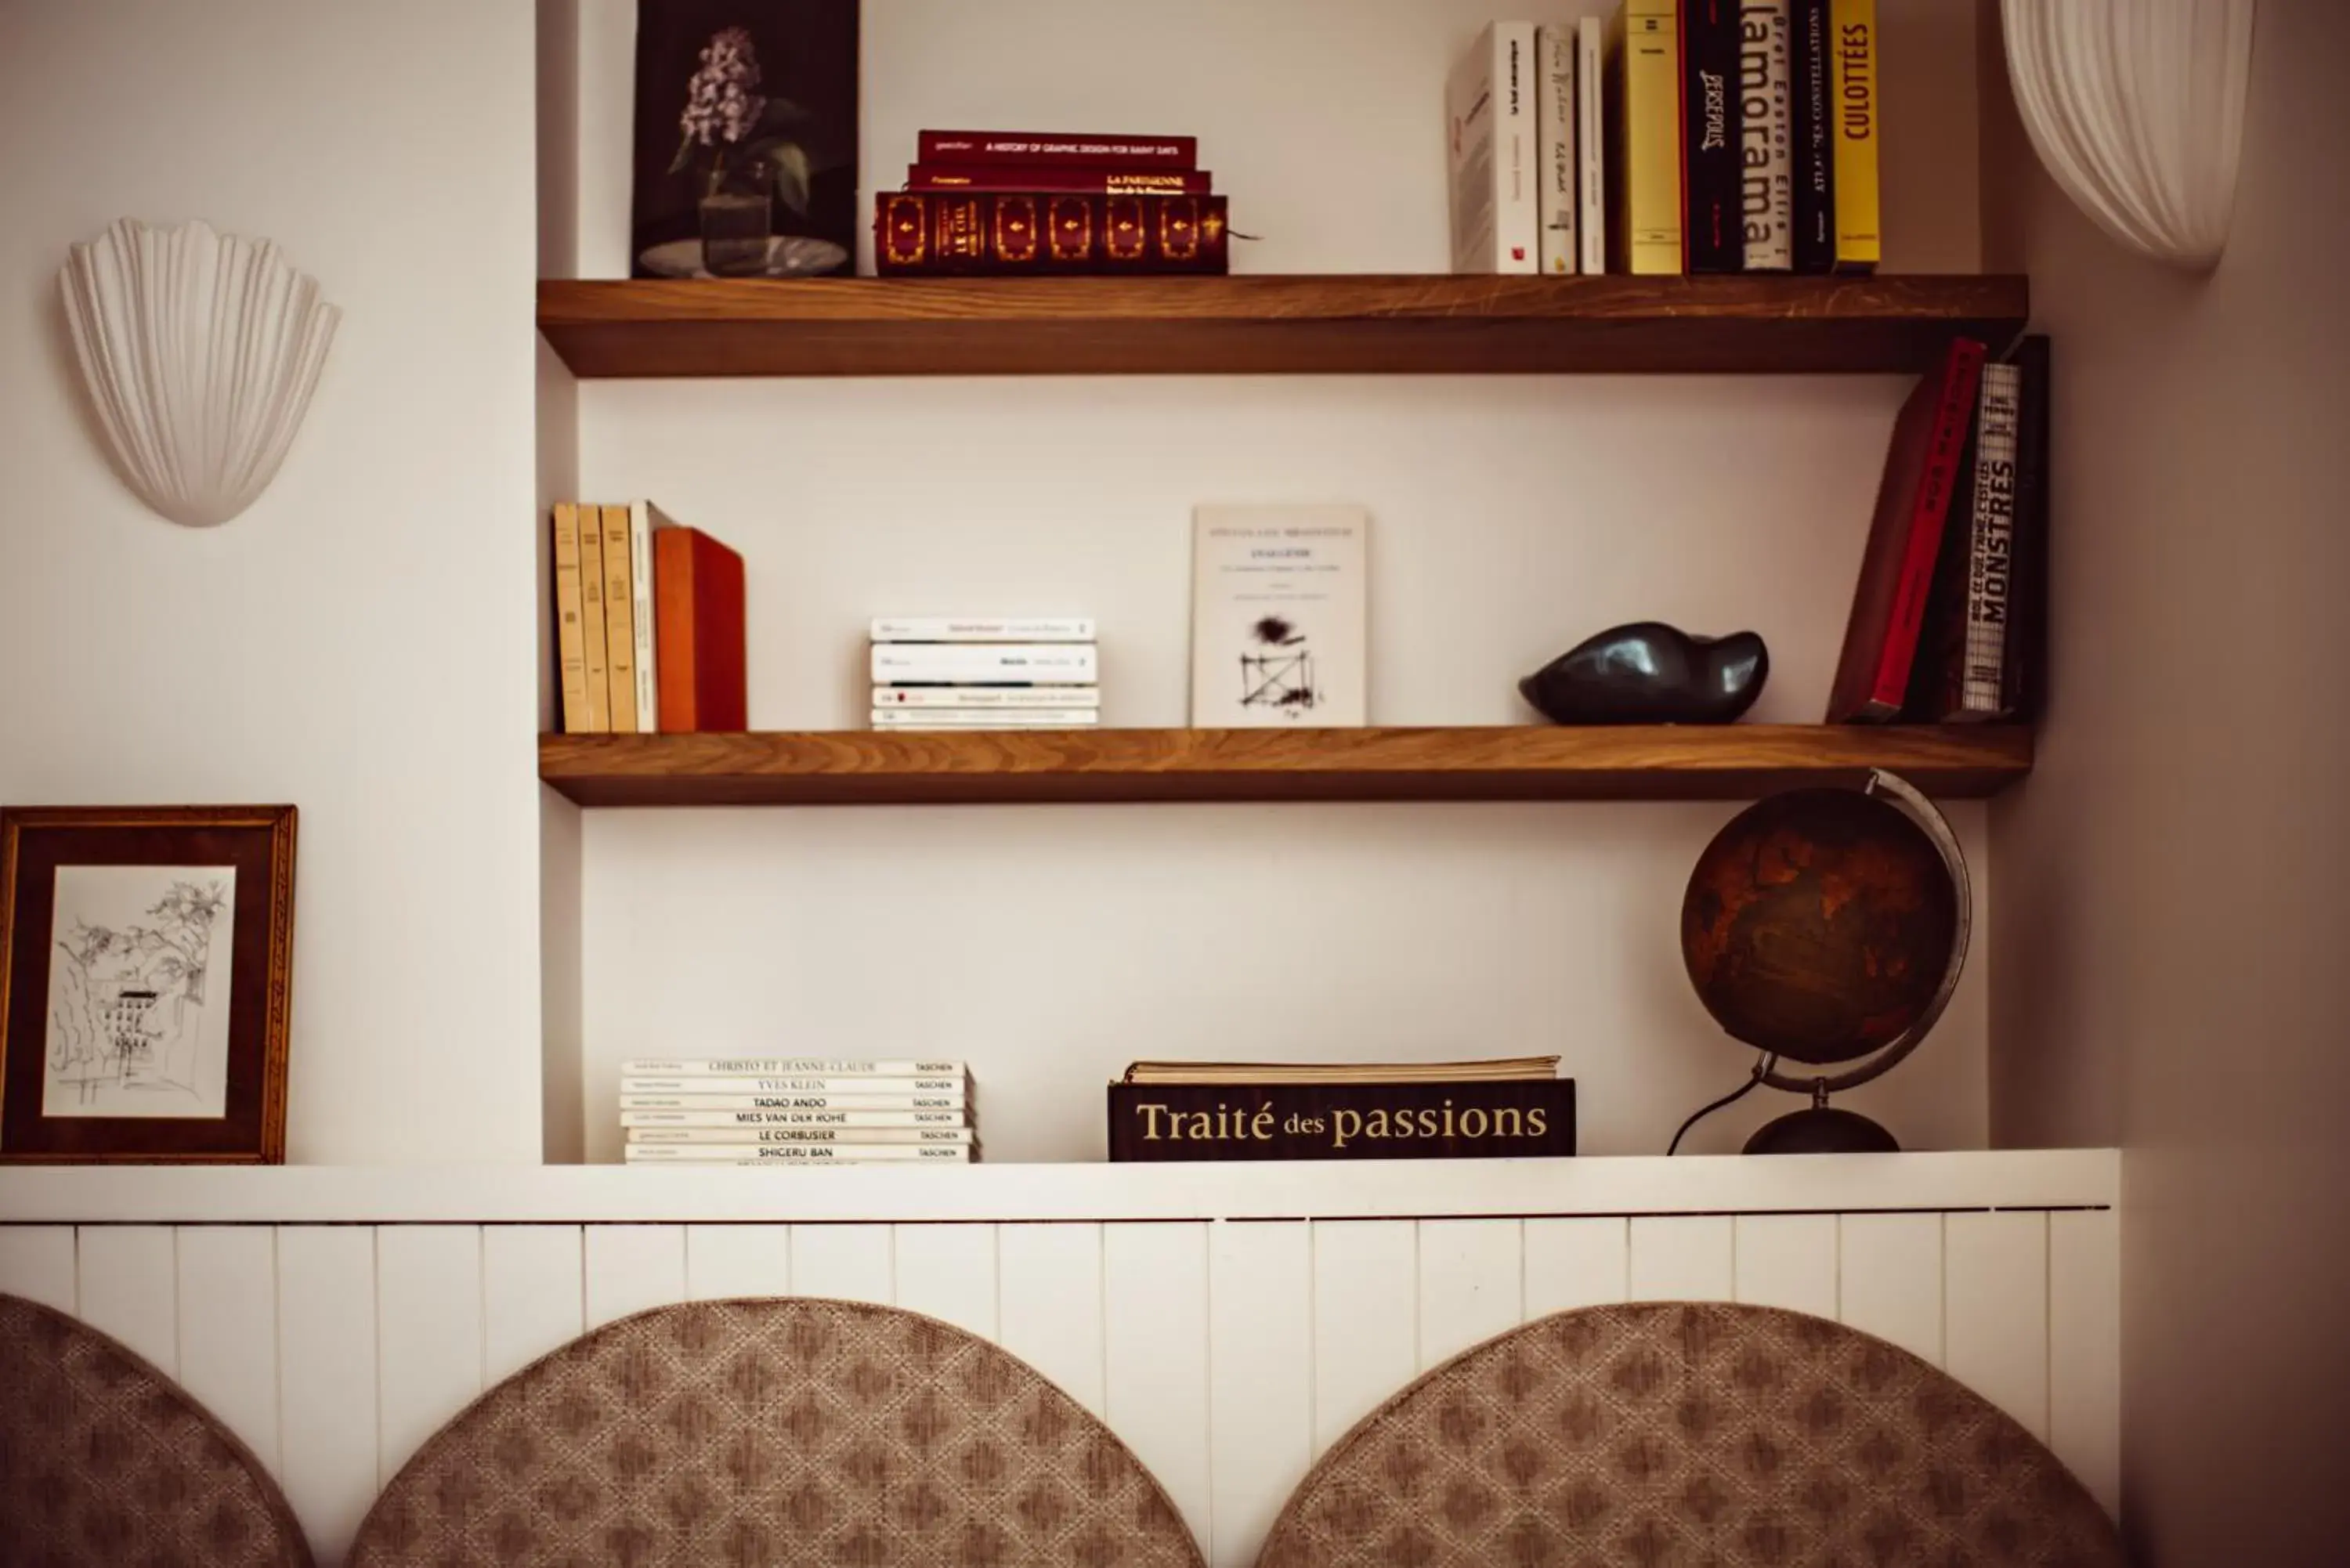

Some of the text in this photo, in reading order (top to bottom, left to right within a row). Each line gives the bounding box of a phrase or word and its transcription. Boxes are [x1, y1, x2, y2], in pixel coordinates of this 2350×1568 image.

[1836, 23, 1870, 139] CULOTTÉES
[1699, 69, 1725, 152] PERSEPOLIS
[1774, 81, 1788, 158] Easton
[1775, 175, 1788, 229] Ellis
[955, 236, 967, 253] LE
[1983, 461, 2013, 623] MONSTRES
[709, 1060, 761, 1072] CHRISTO
[764, 1060, 778, 1072] ET
[915, 1062, 953, 1071] TASCHEN
[758, 1079, 826, 1090] YVES KLEIN
[915, 1081, 952, 1089] TASCHEN
[754, 1097, 826, 1107] TADAO ANDO
[913, 1098, 950, 1107] TASCHEN
[736, 1113, 847, 1122] MIES VAN DER ROHE
[915, 1114, 952, 1122] TASCHEN
[1137, 1100, 1548, 1147] Traité des passions
[759, 1130, 836, 1140] LE CORBUSIER
[920, 1131, 958, 1140] TASCHEN
[758, 1147, 833, 1157] SHIGERU BAN
[919, 1148, 956, 1157] TASCHEN
